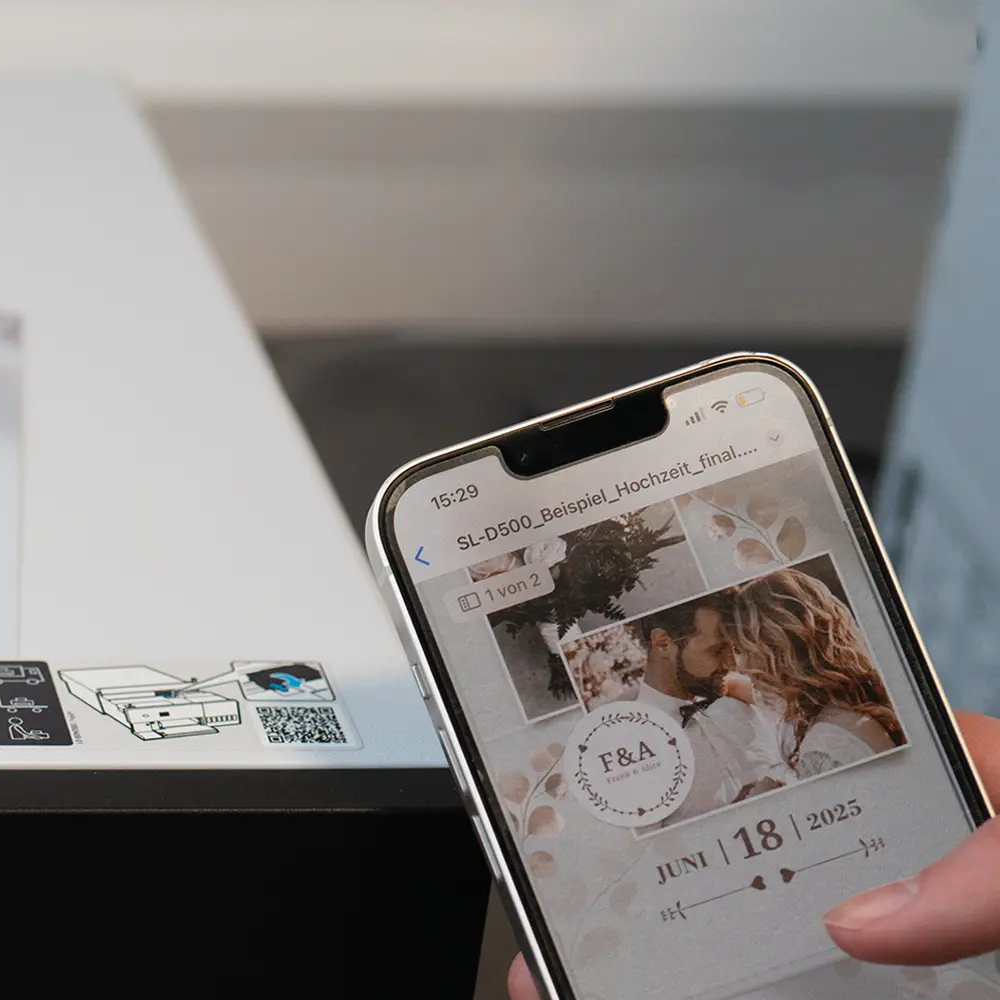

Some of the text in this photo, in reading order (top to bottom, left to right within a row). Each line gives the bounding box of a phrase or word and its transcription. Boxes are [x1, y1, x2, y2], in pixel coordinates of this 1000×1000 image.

[431, 484, 479, 510] 15:29
[485, 573, 541, 602] 1 von 2
[598, 741, 656, 774] F&A
[607, 771, 631, 784] Frank
[641, 761, 661, 773] Alice
[656, 799, 863, 885] JUNI 18 2025
